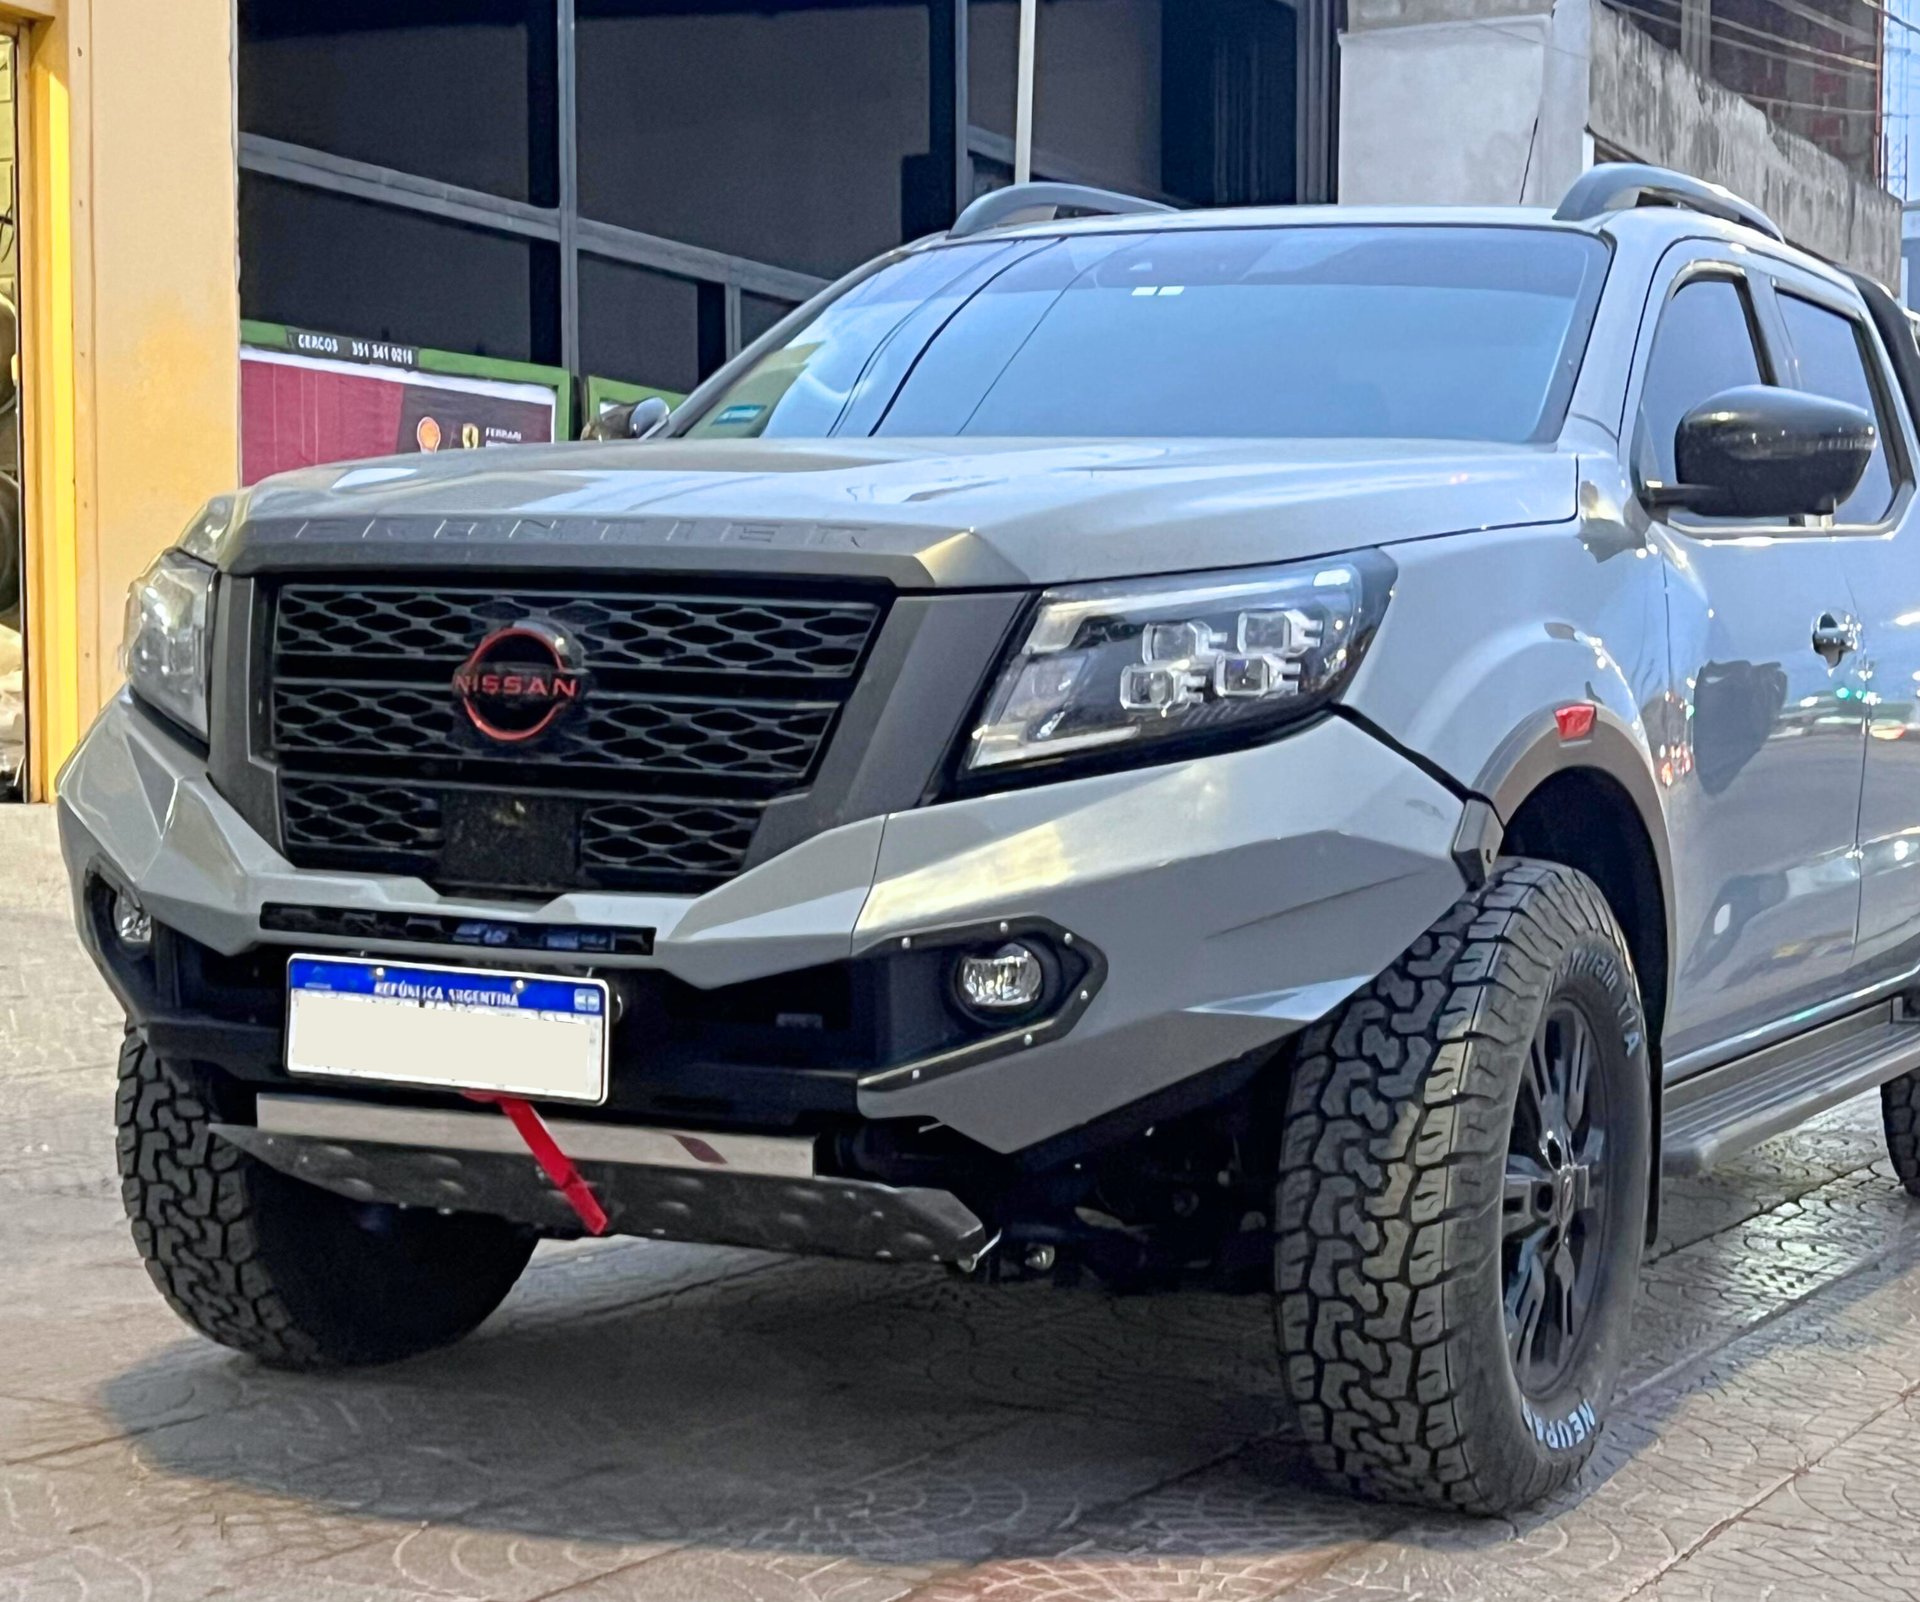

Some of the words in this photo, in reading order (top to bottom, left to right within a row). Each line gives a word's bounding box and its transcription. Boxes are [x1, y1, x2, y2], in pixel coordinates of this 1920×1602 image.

[298, 334, 339, 353] CERCOS
[294, 516, 870, 549] FRONTIER
[454, 674, 577, 697] NISSAN
[447, 988, 520, 1008] ARGENTINA
